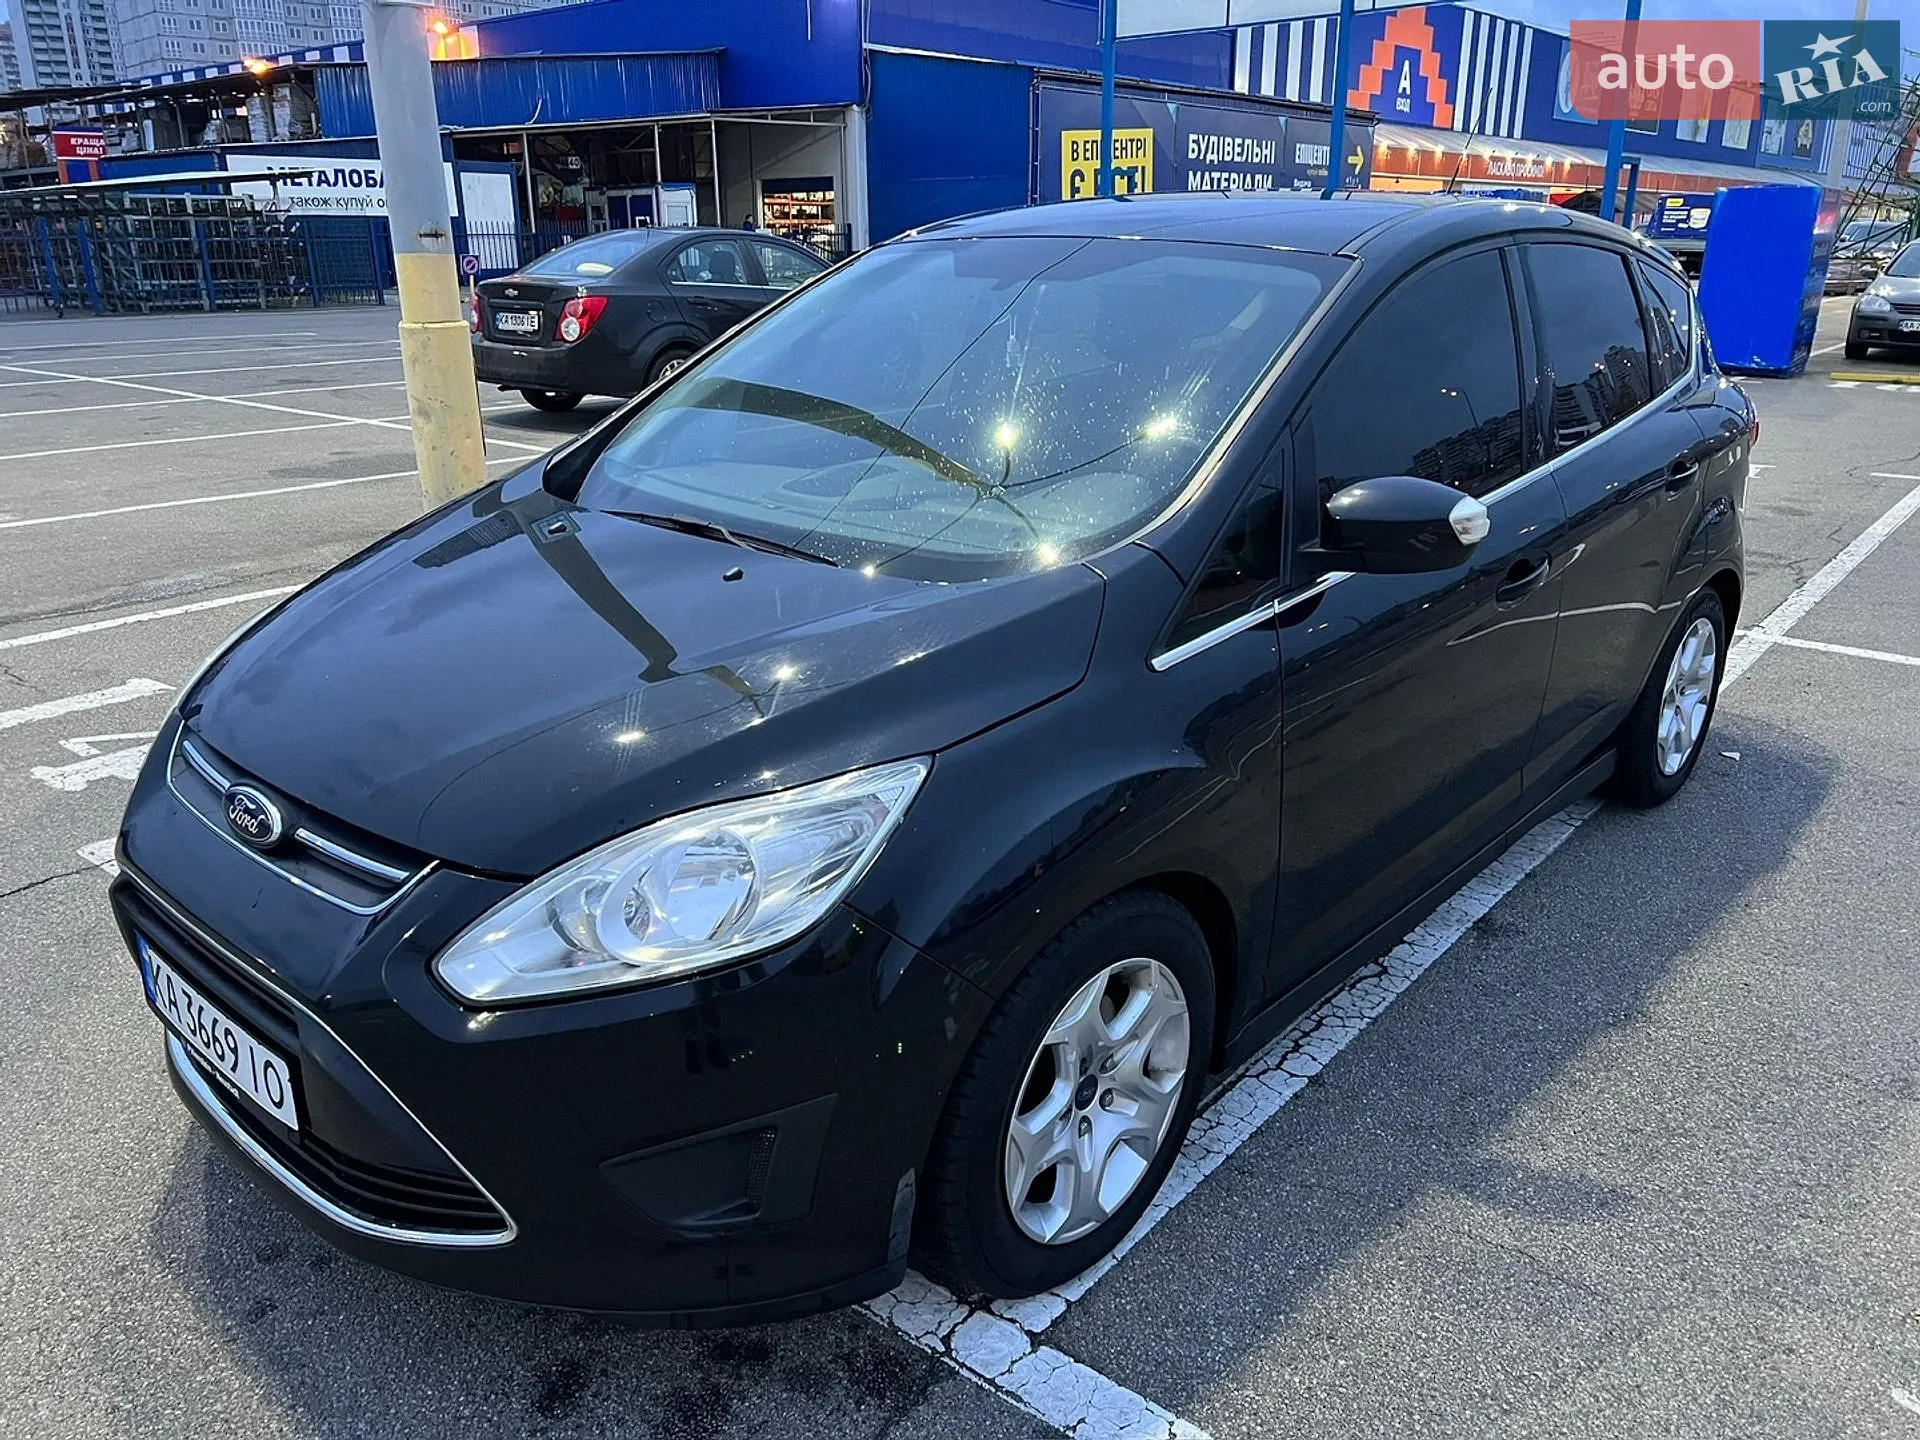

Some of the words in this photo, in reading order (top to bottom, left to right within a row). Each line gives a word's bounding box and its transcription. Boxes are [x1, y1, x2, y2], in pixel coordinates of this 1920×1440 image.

[1398, 60, 1410, 95] А
[70, 138, 106, 147] КРАЩА
[1071, 140, 1080, 162] В
[1083, 138, 1147, 161] ЕПЕНТРІ
[1187, 133, 1276, 165] БУДІВЕЛЬНІ
[1187, 170, 1273, 191] МАТЕРІАЛИ
[289, 197, 331, 207] також
[336, 195, 373, 211] купуй
[229, 794, 262, 834] Ford
[150, 950, 182, 1025] KA
[182, 987, 240, 1074] 3669
[249, 1045, 285, 1110] IO
